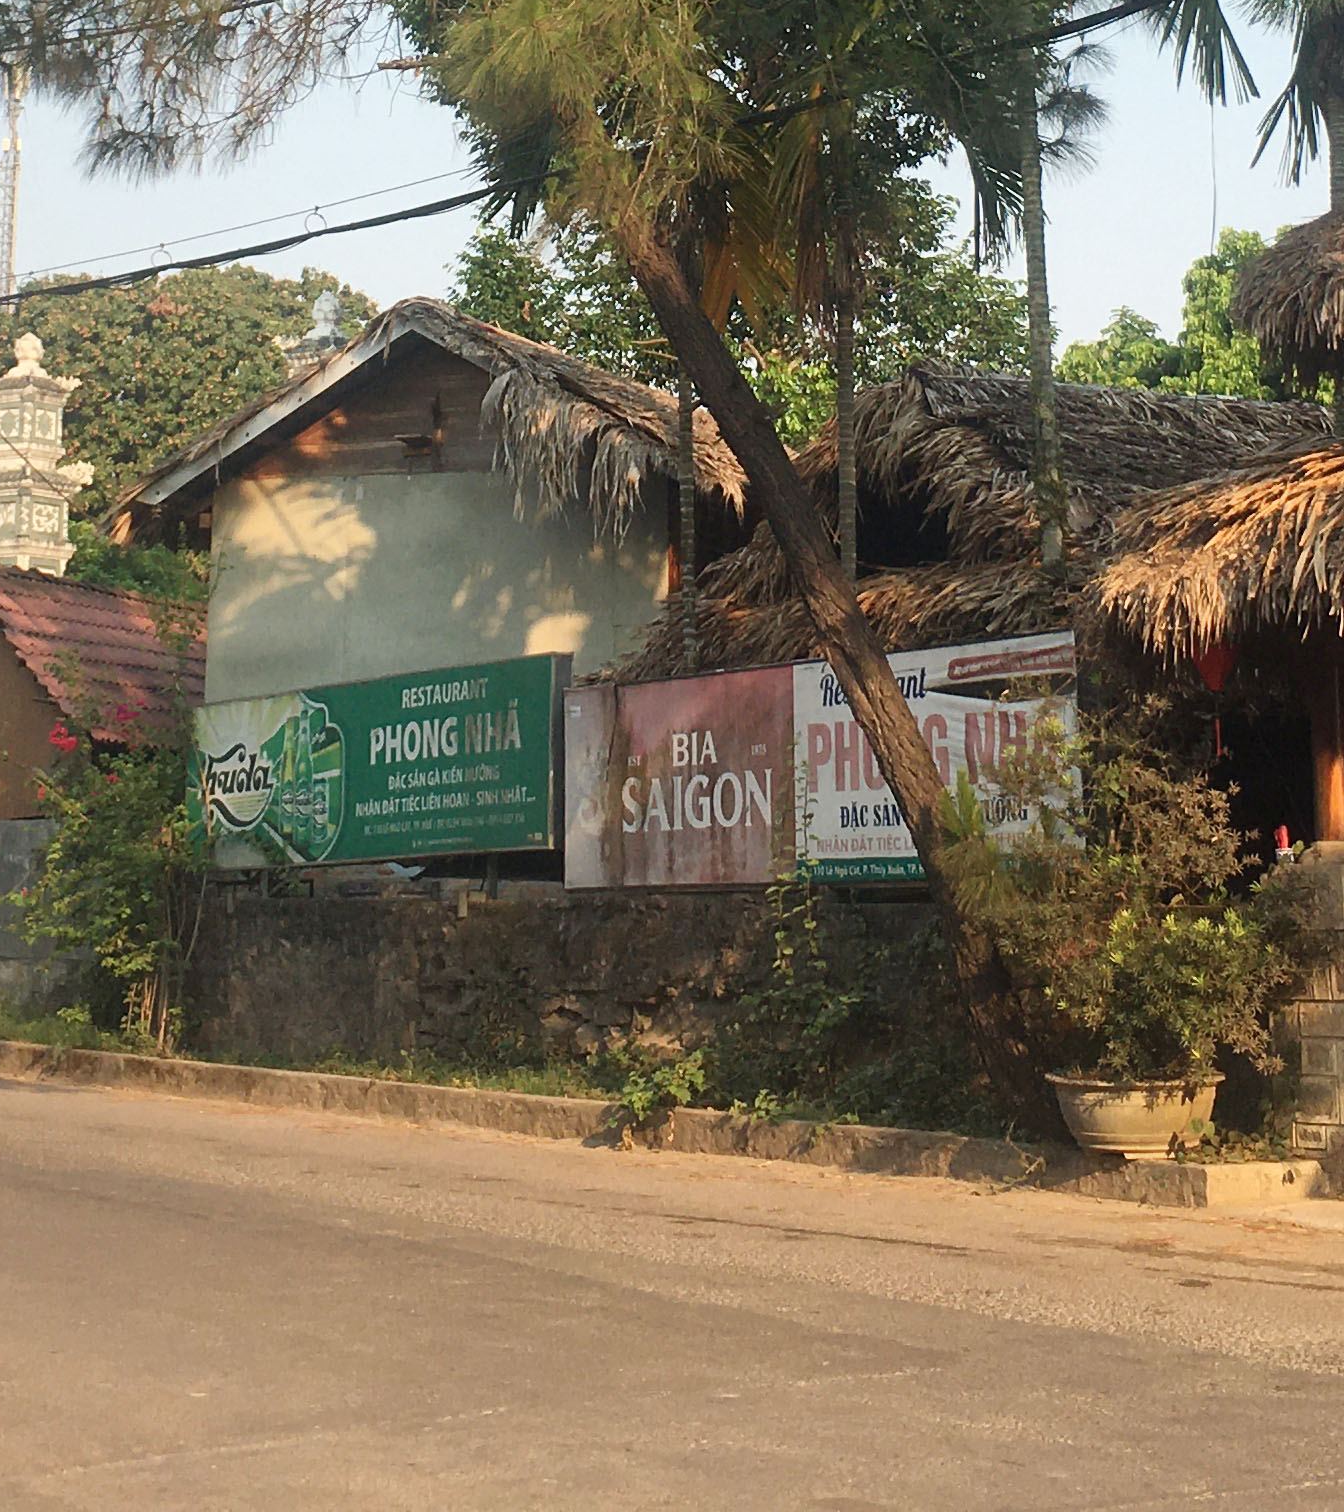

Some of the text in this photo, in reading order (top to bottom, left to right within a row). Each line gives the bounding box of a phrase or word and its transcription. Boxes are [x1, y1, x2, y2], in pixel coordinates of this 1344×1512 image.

[401, 678, 489, 709] RESTAURANT
[820, 666, 927, 708] Reant
[369, 716, 459, 766] PHONG
[672, 730, 719, 768] BIA
[807, 713, 951, 794] PHOG
[442, 791, 470, 809] HOAN
[476, 790, 499, 807] SINH
[621, 768, 773, 834] SAIGON
[840, 800, 869, 832] ĐẶC
